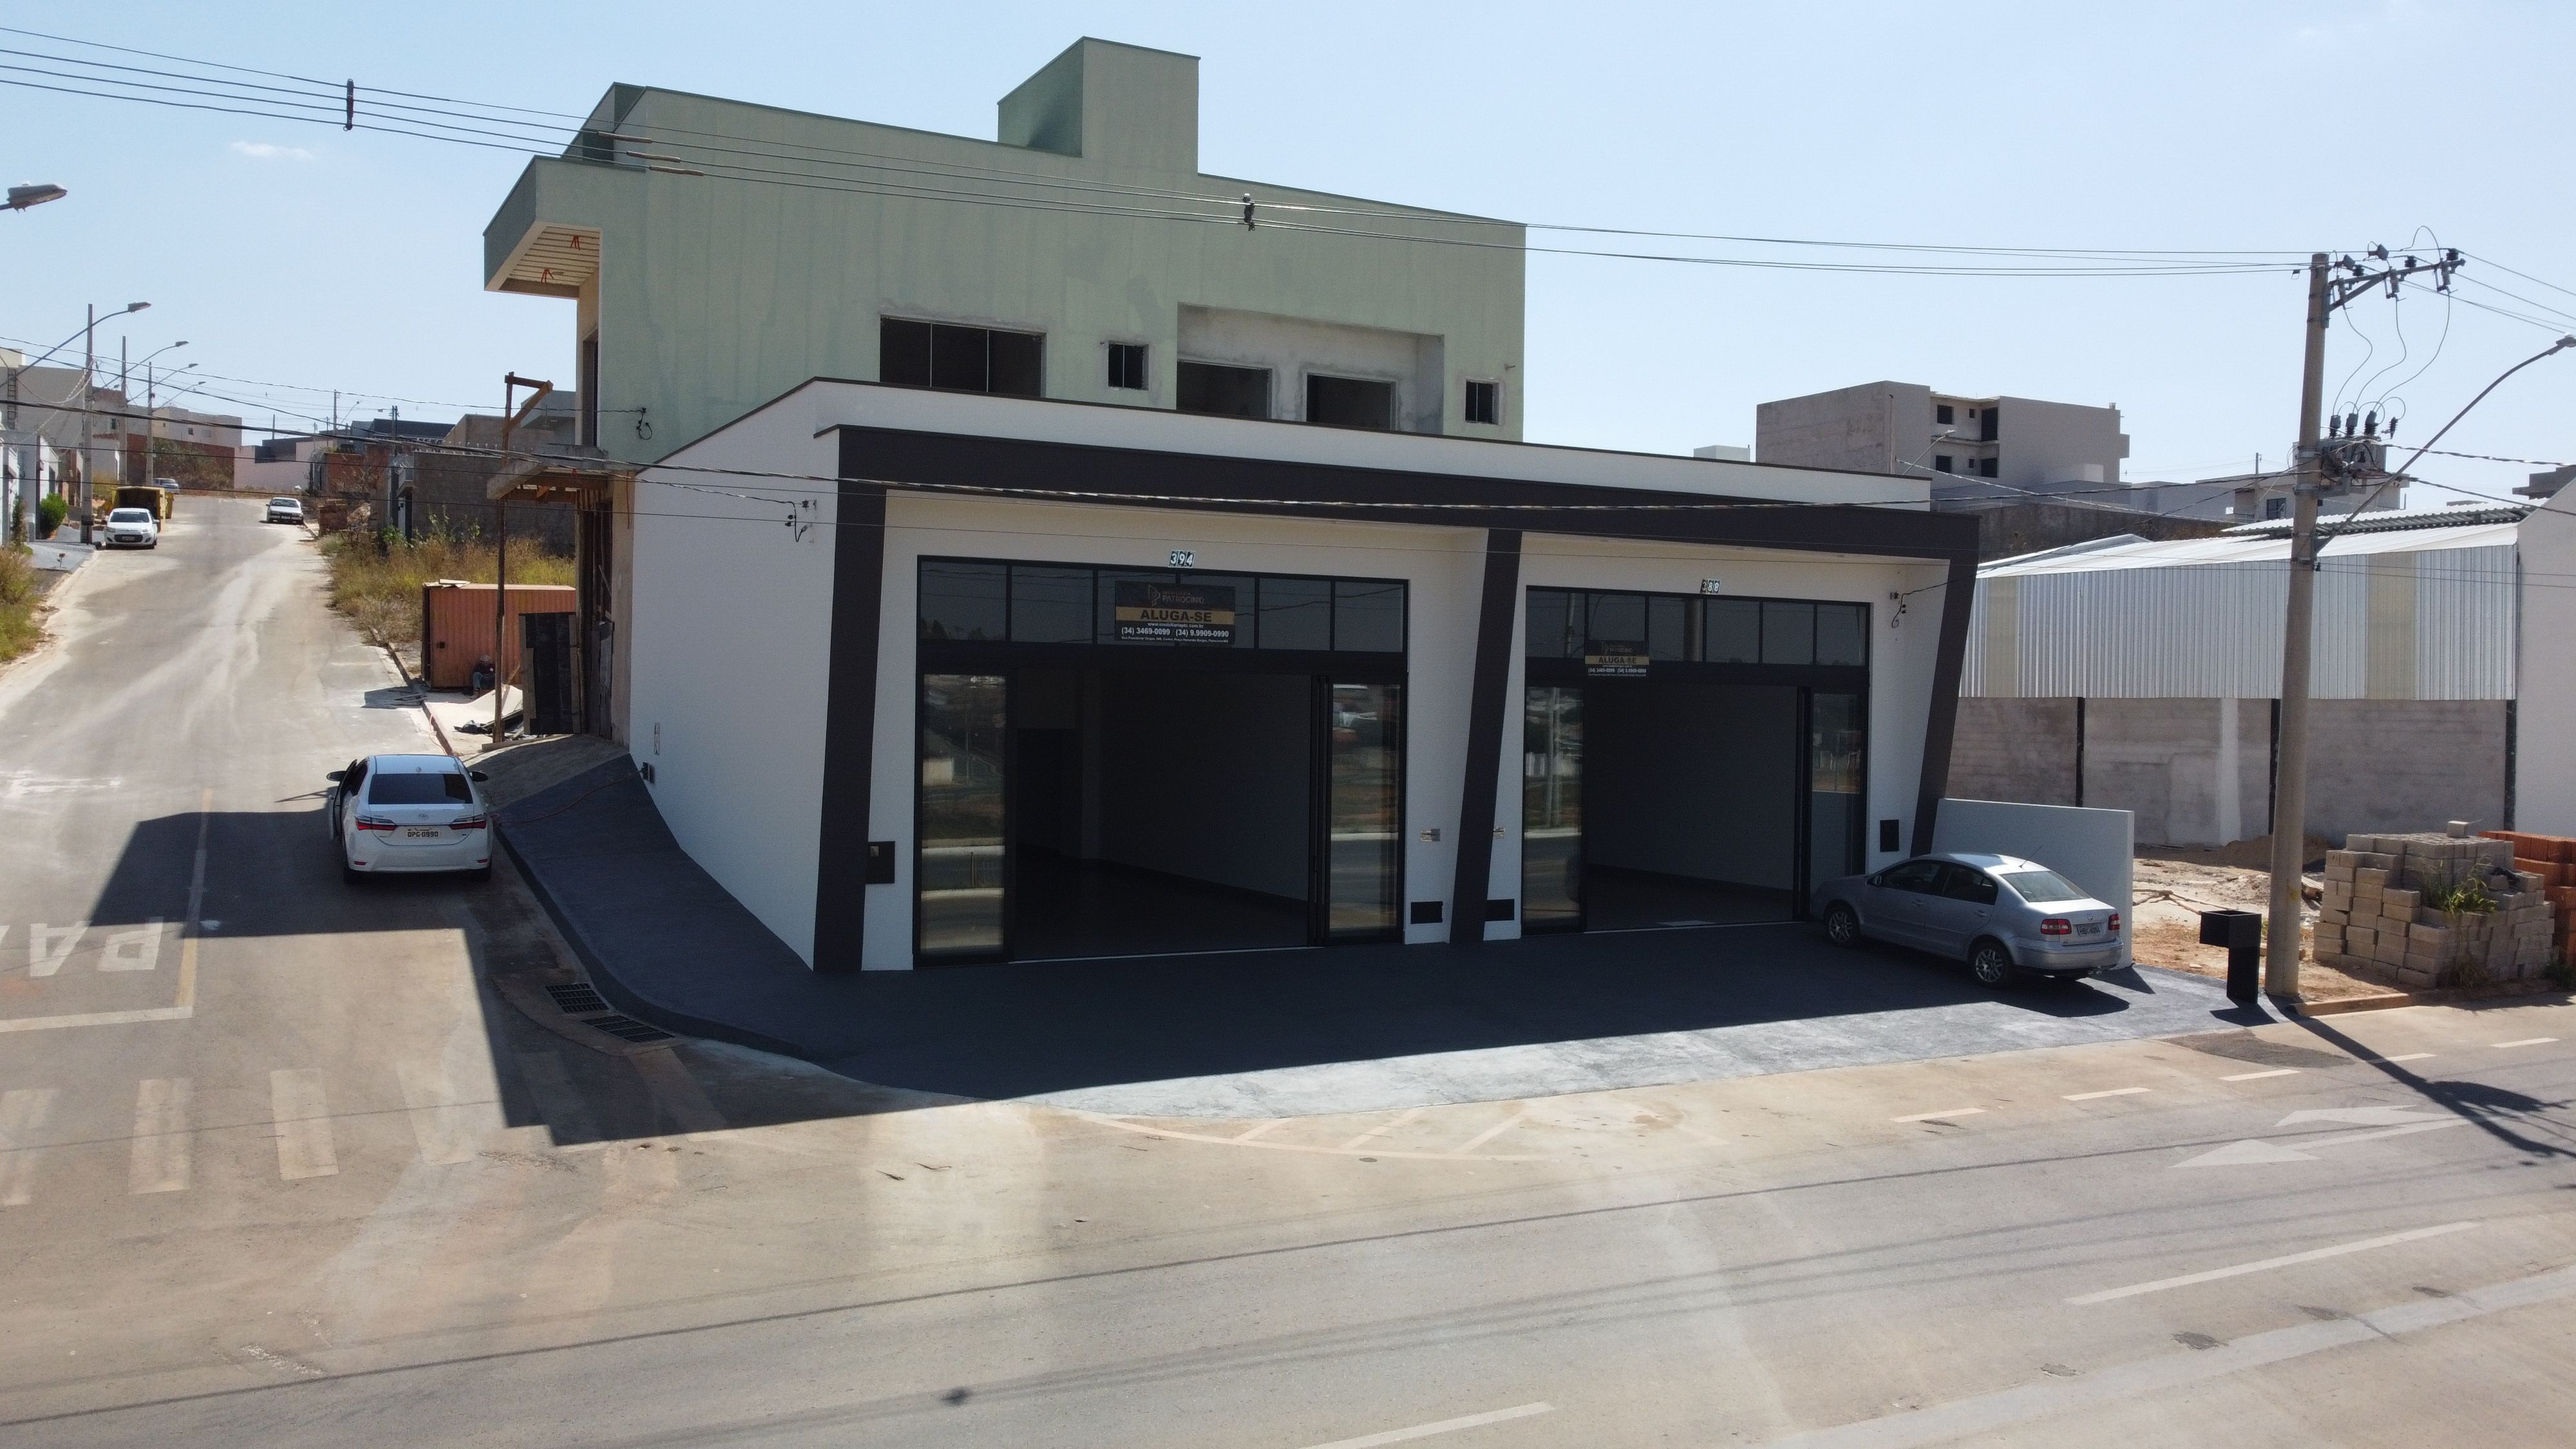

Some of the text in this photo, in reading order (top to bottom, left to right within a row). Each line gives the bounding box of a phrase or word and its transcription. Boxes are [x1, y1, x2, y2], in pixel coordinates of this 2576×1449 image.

[1170, 551, 1195, 567] 394
[1701, 580, 1719, 592] 388
[1141, 609, 1212, 622] ALUGA-SE
[1121, 627, 1134, 635] (34)
[1175, 629, 1188, 637] (34)
